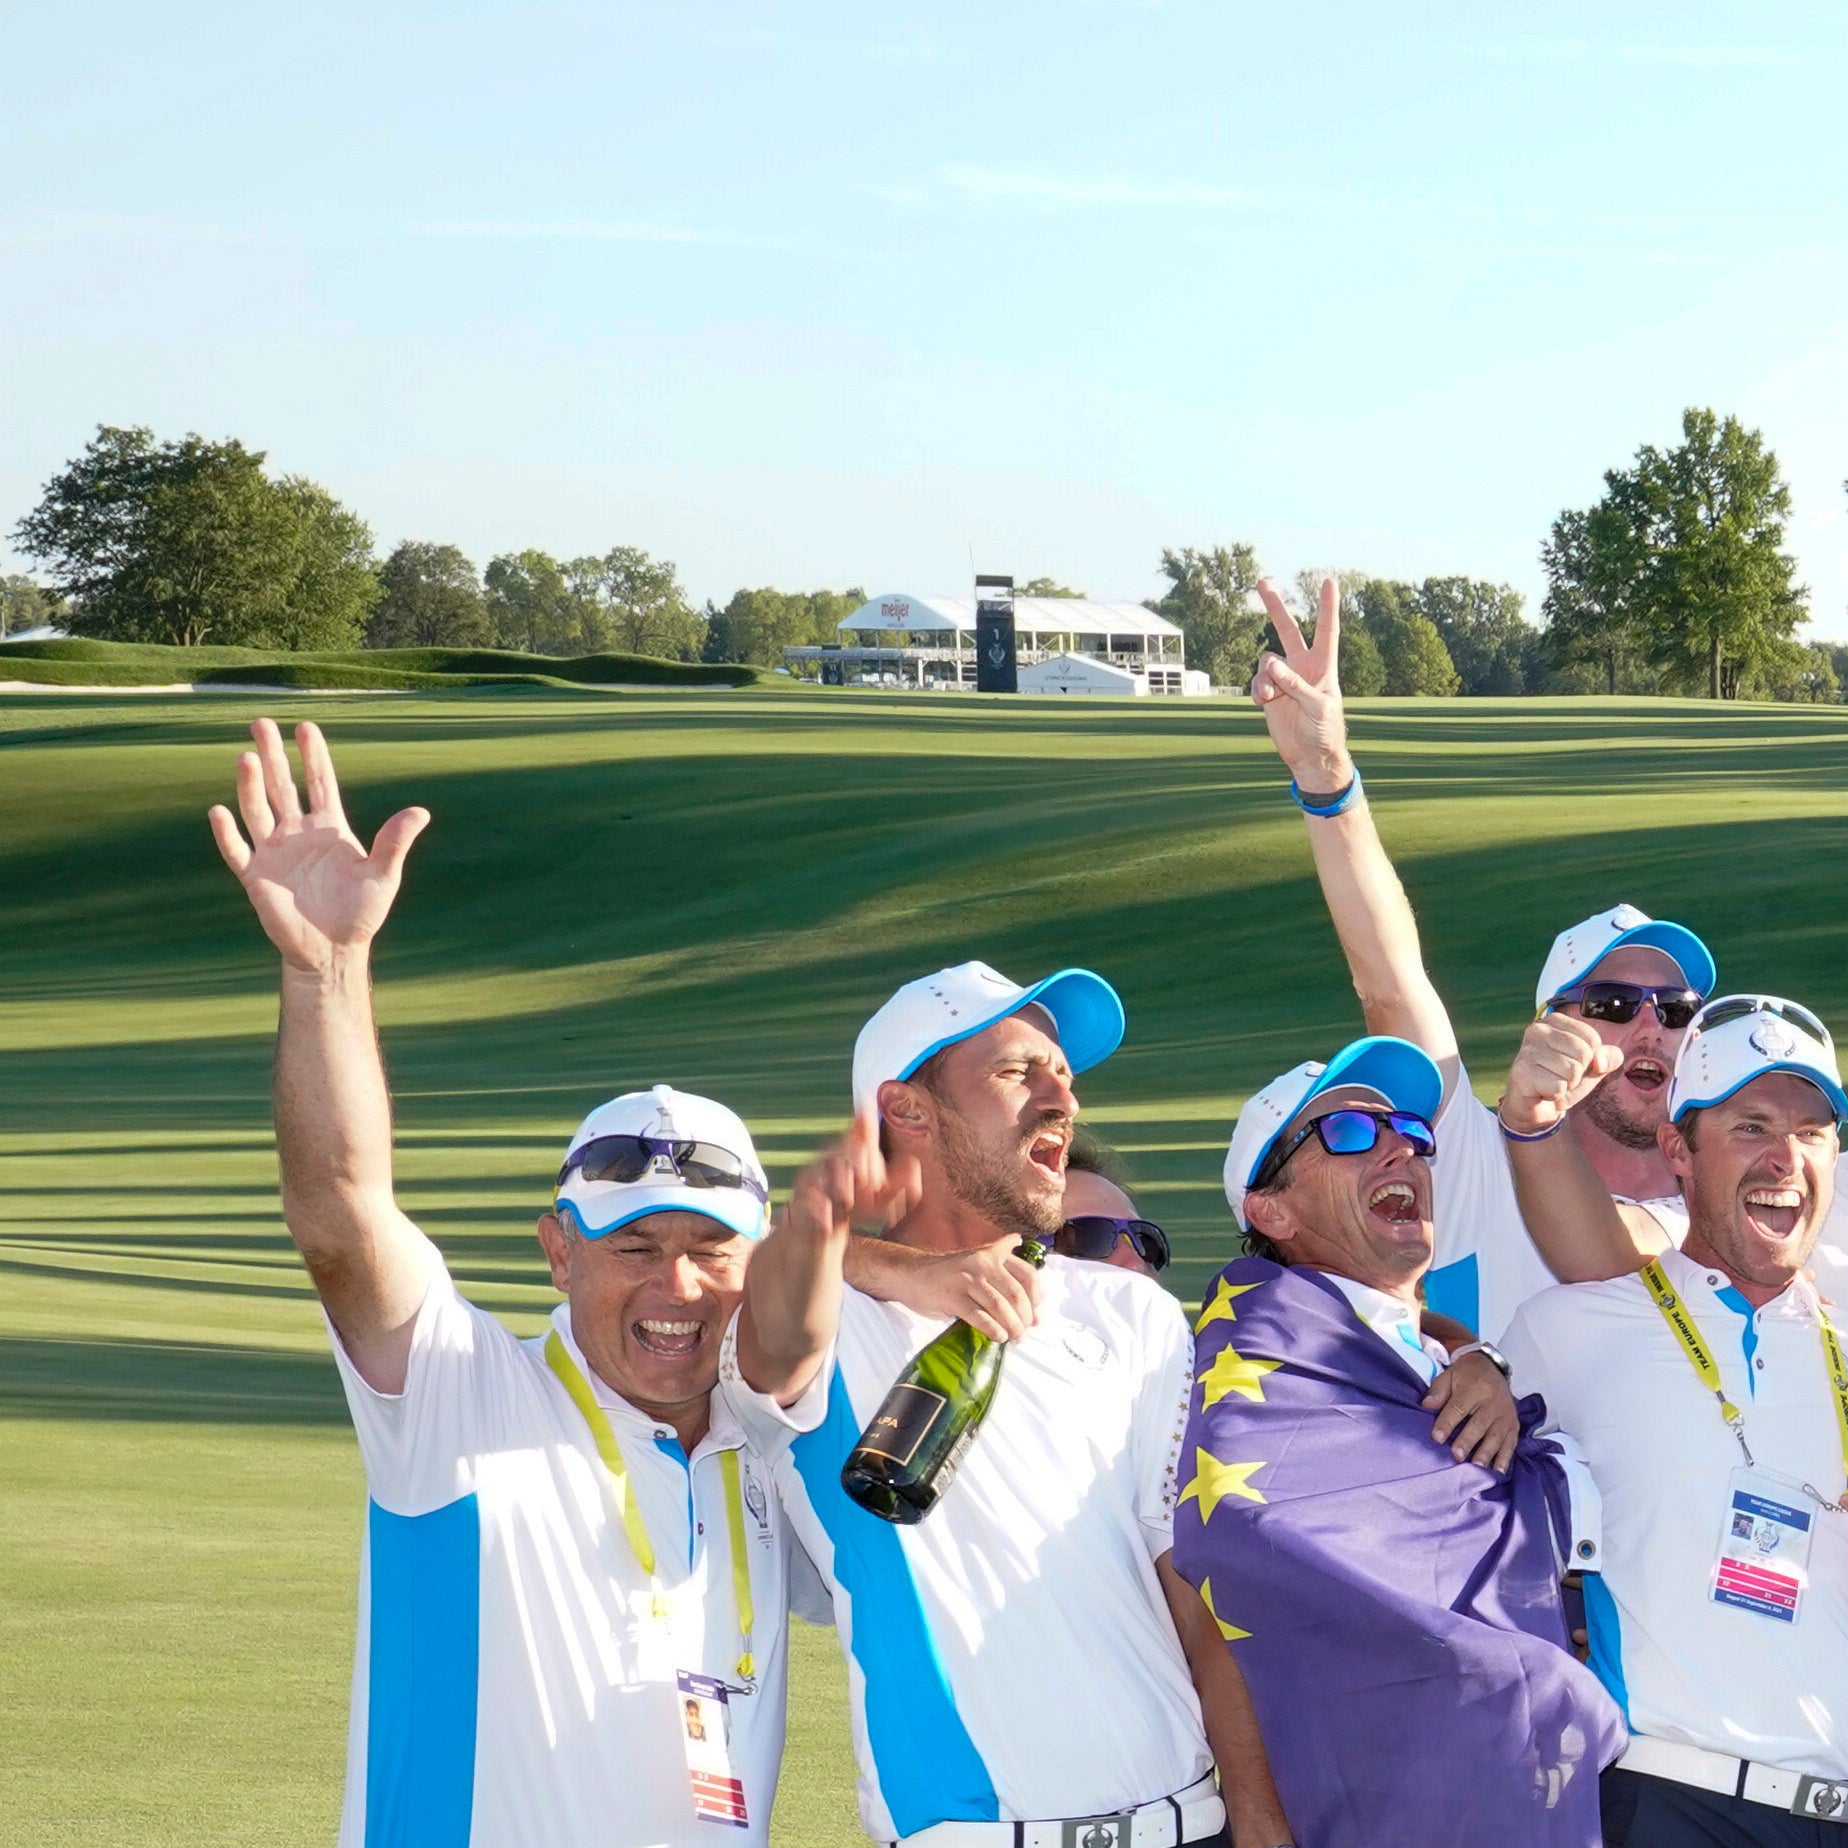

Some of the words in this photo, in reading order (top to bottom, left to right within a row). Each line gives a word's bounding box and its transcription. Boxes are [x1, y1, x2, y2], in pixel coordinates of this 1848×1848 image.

[881, 603, 909, 621] meijer
[993, 628, 999, 640] 1
[1671, 1310, 1697, 1346] EUROPE
